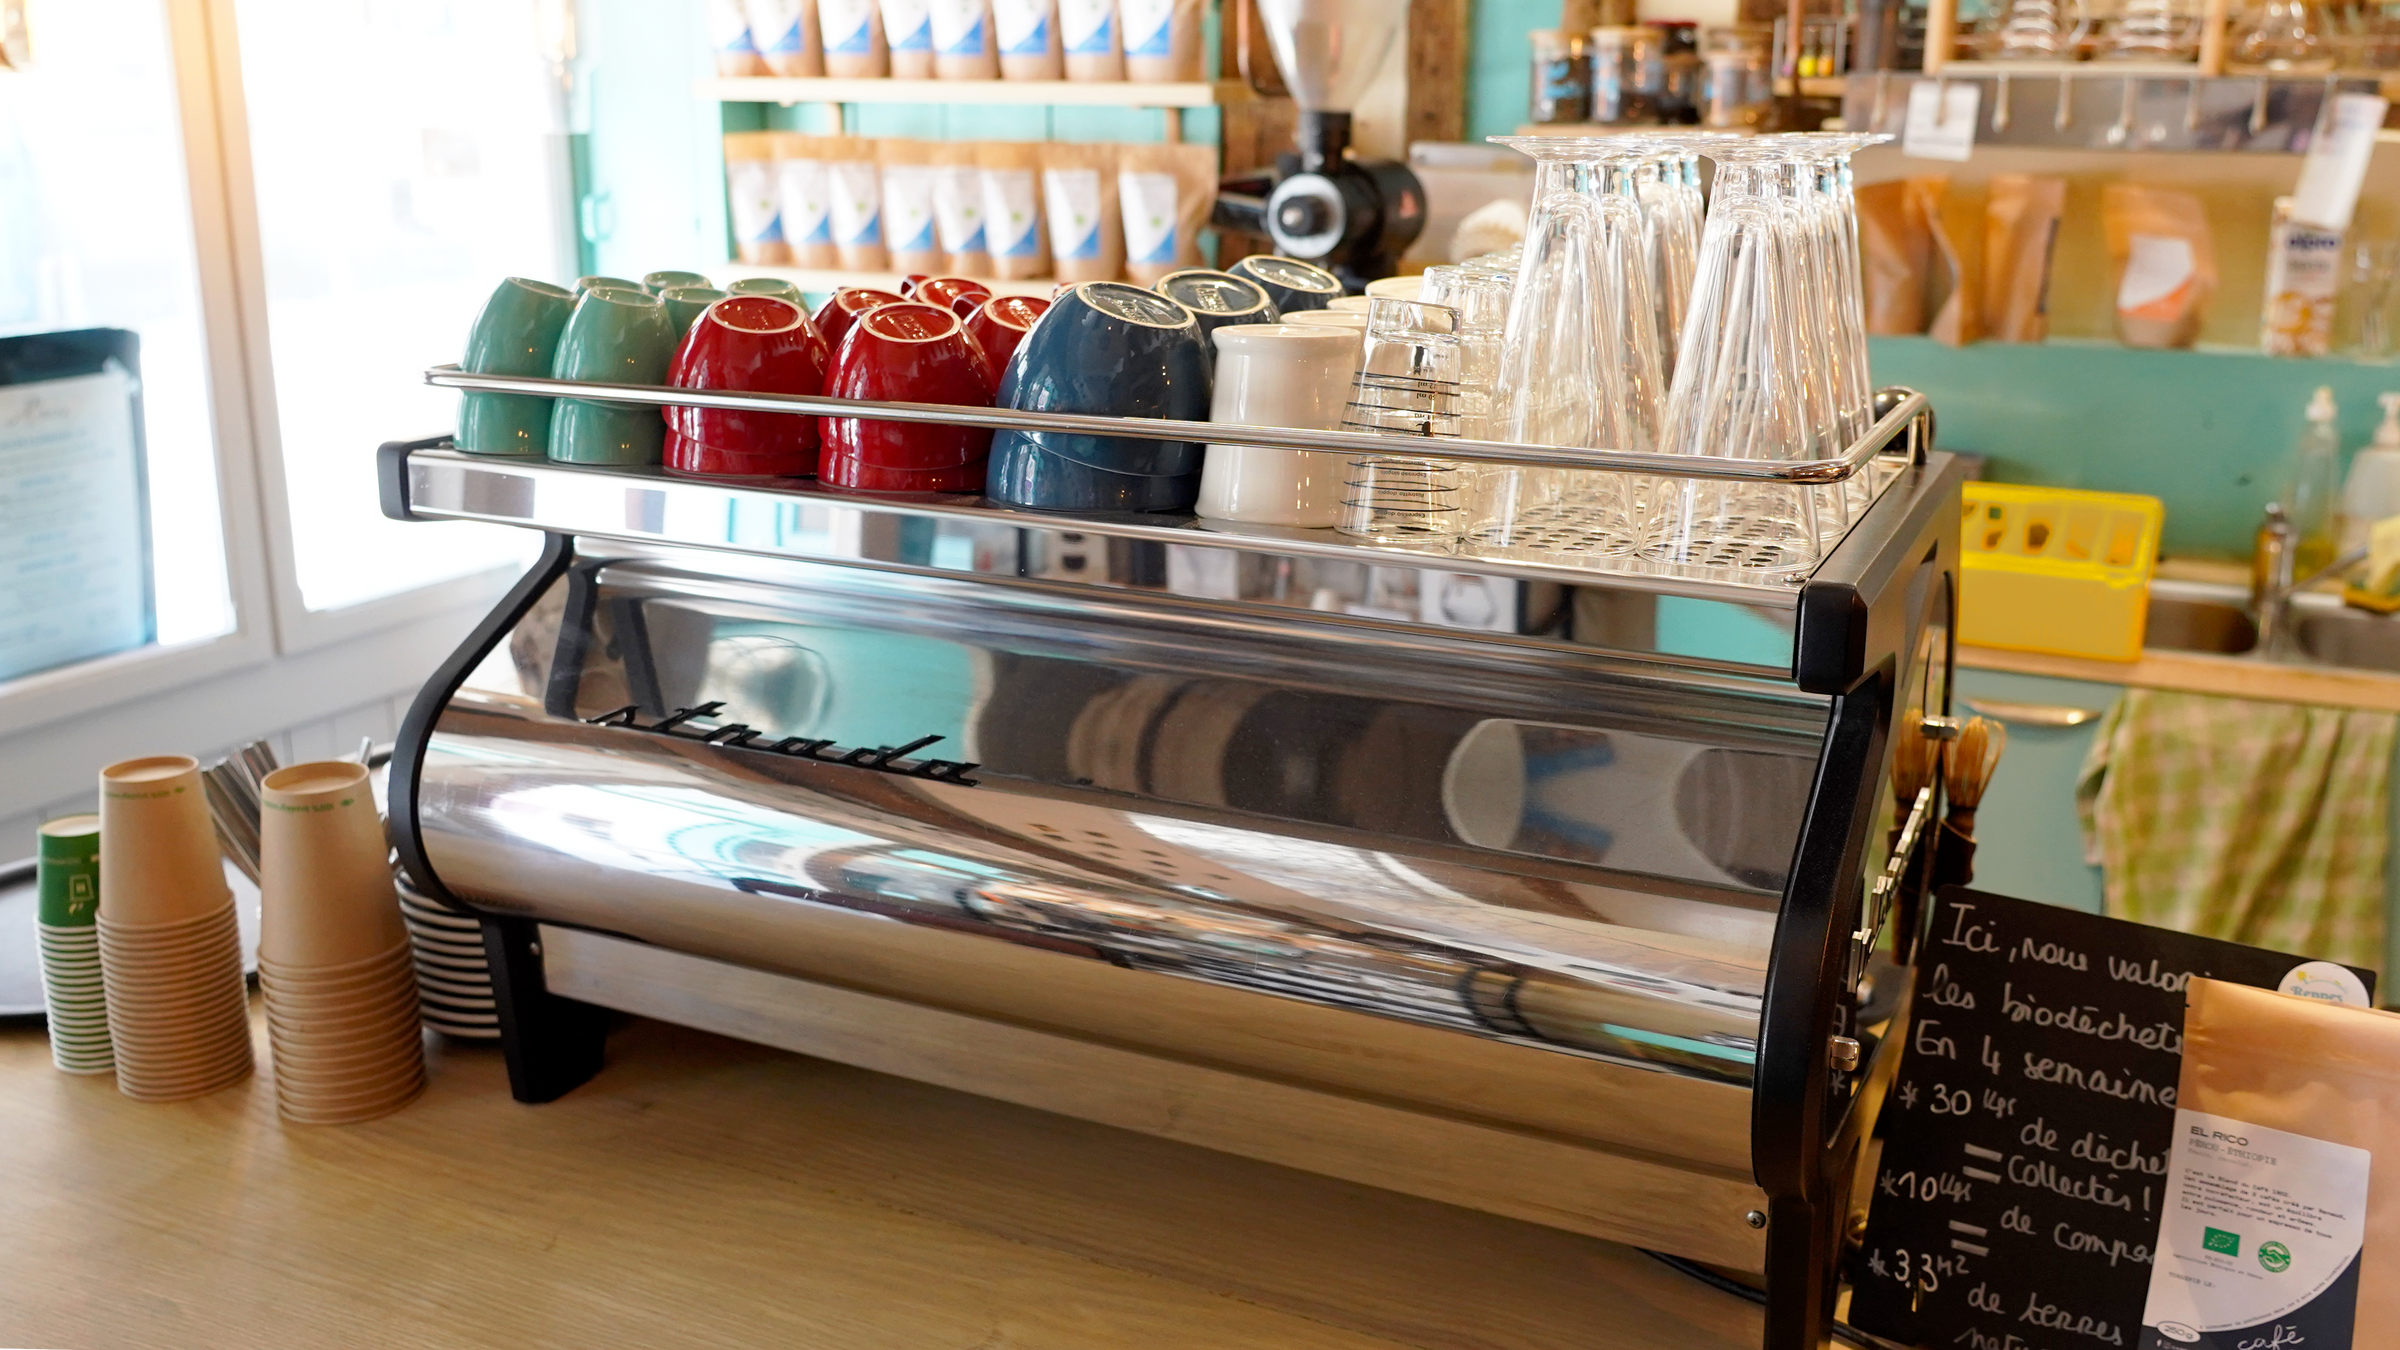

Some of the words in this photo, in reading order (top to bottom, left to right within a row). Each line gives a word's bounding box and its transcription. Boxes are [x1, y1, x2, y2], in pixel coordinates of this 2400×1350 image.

[1397, 511, 1426, 519] Espresso
[1942, 903, 2000, 952] Ici
[1922, 963, 1976, 1010] les
[1915, 1019, 1956, 1060] En
[1982, 1035, 2001, 1075] 4
[1930, 1084, 1972, 1116] 30
[2020, 1117, 2060, 1151] de
[2190, 1126, 2209, 1138] EL
[2212, 1131, 2249, 1147] RICO
[2001, 1206, 2037, 1235] de
[1968, 1282, 2005, 1314] de
